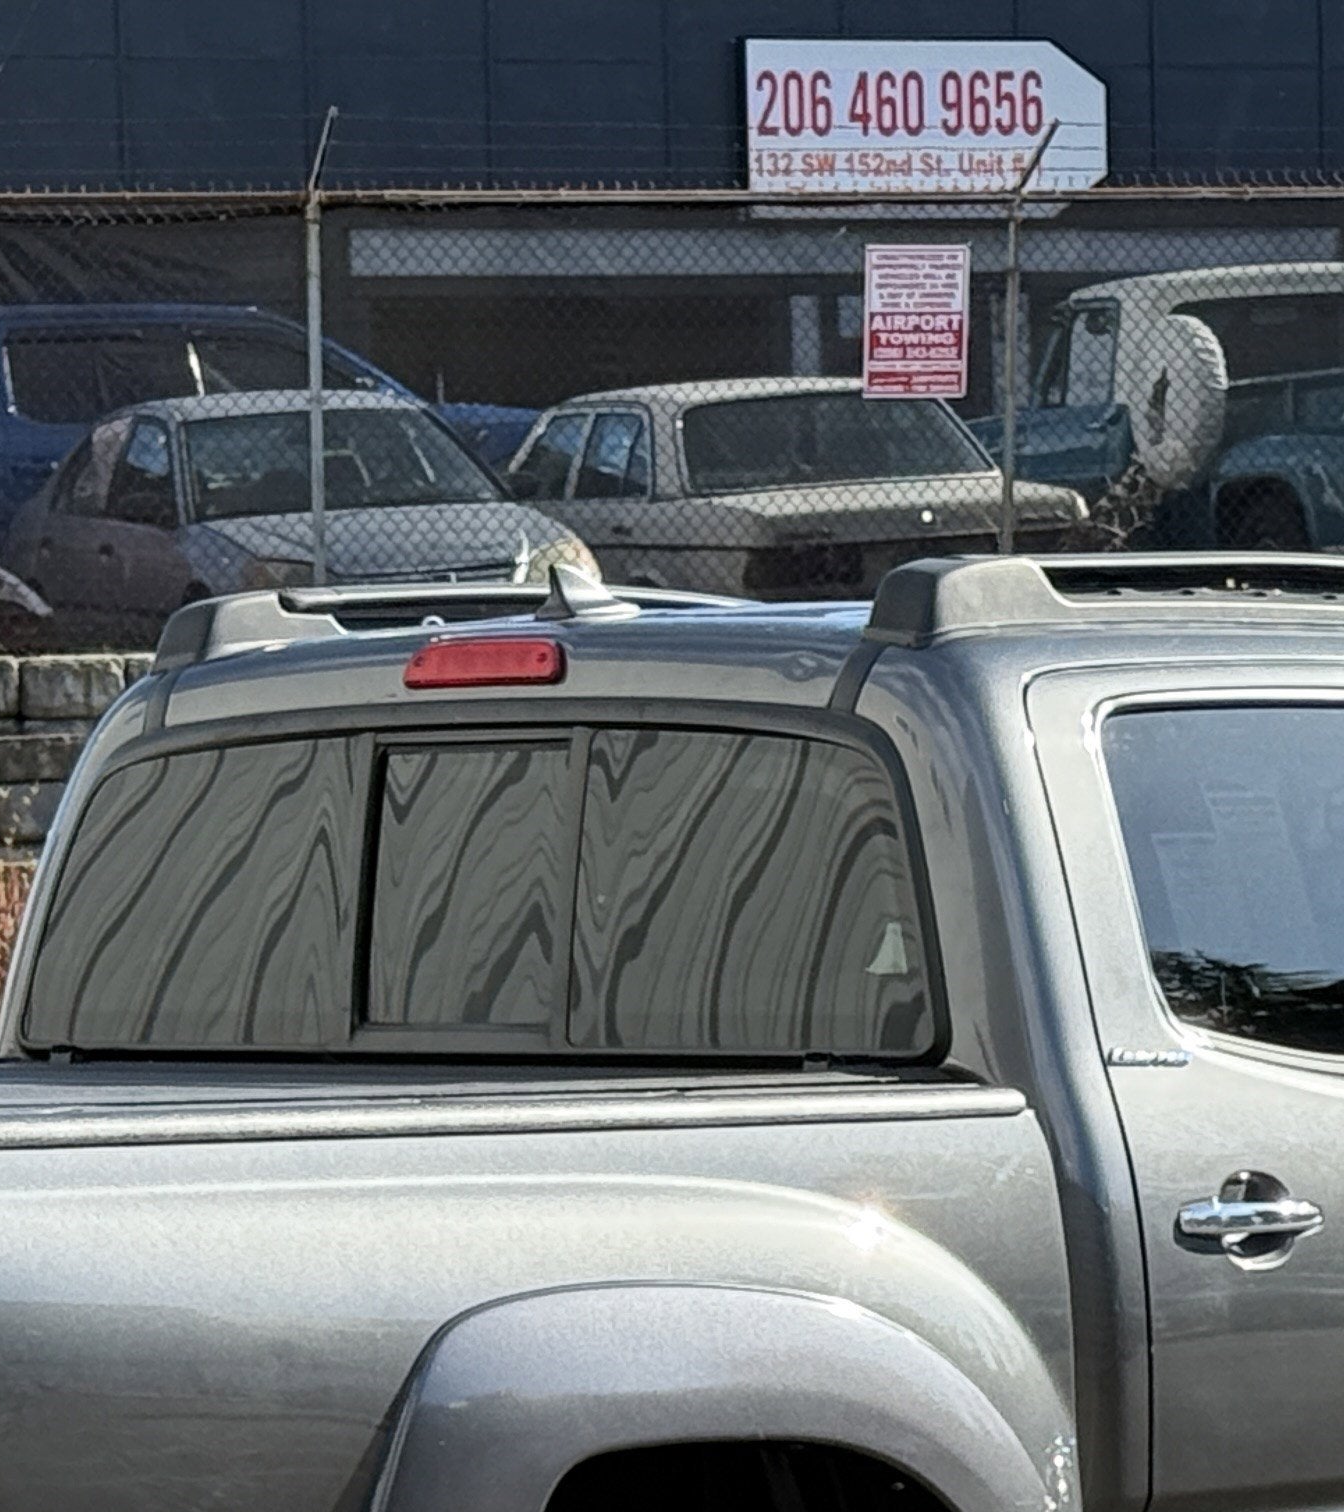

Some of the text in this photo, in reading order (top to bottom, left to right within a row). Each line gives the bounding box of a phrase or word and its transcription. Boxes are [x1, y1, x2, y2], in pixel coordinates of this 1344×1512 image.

[756, 69, 1044, 137] 206 460 9656
[755, 152, 792, 178] 132
[801, 152, 836, 178] SW
[844, 152, 913, 178] 152nd
[958, 152, 1005, 178] Unit
[871, 314, 961, 331] AIRPORT
[876, 332, 955, 345] TOWING
